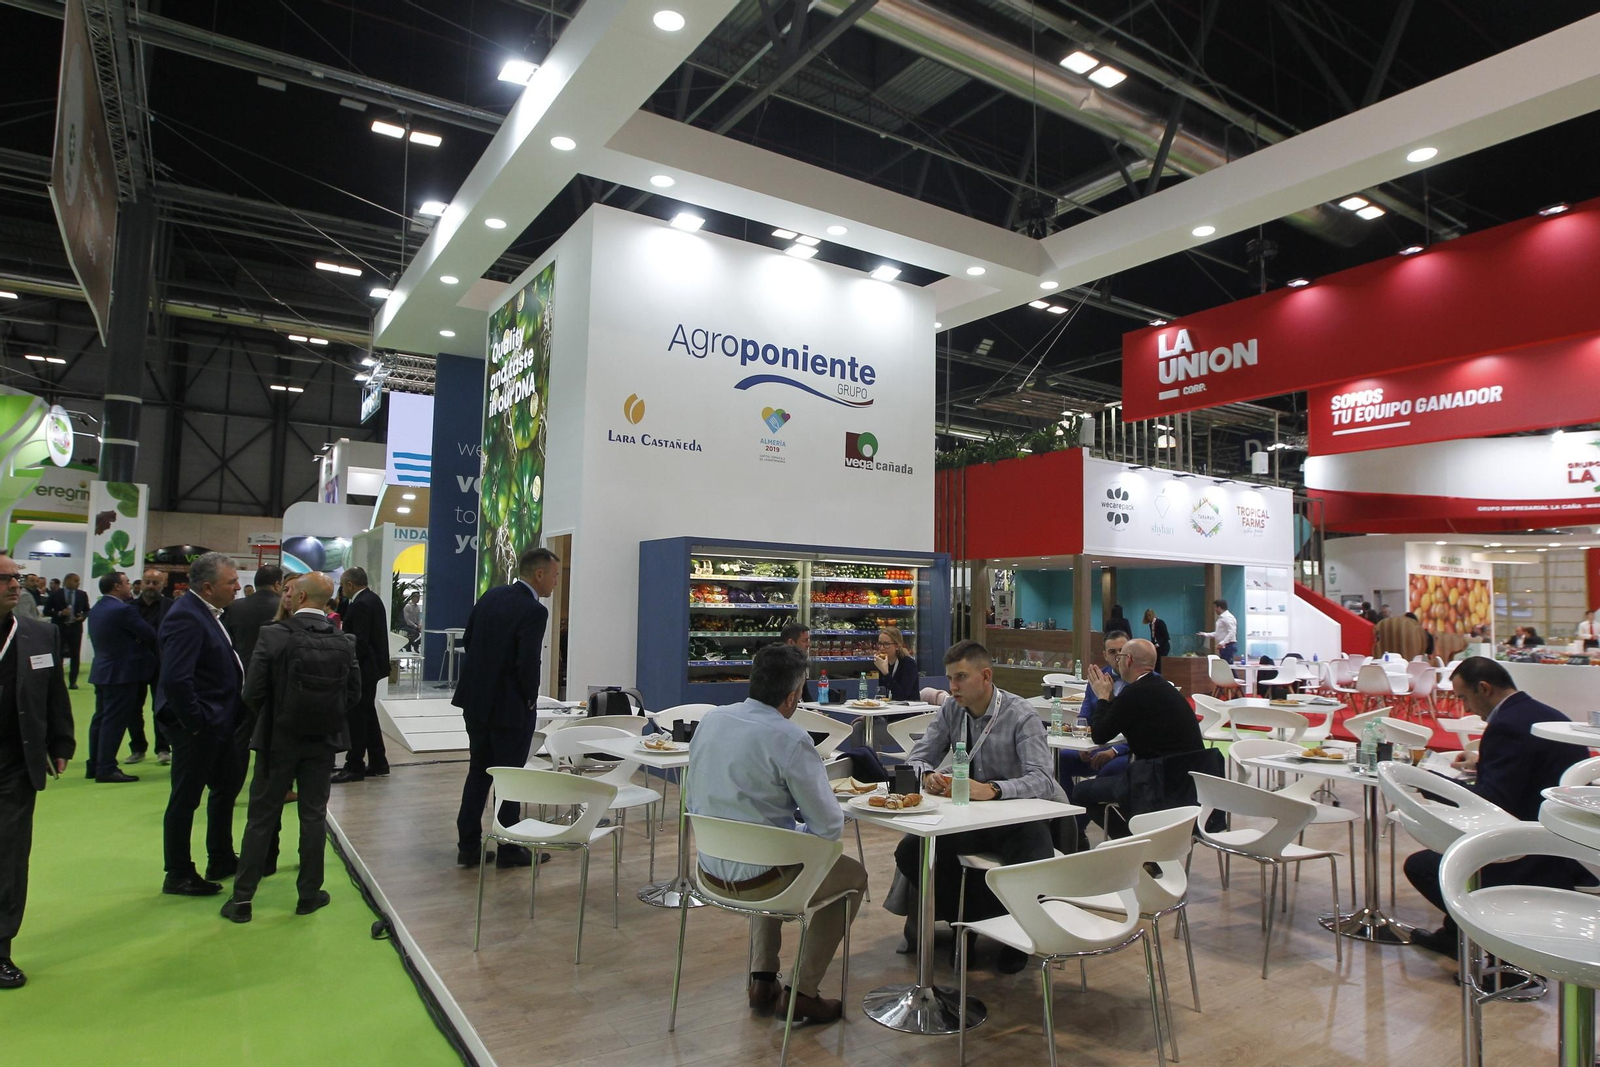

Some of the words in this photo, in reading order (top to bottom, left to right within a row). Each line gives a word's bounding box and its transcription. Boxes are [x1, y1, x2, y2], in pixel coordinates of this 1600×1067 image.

[492, 327, 525, 363] Quality
[1158, 329, 1194, 359] LA
[667, 323, 876, 385] Agroponiente
[1158, 338, 1258, 384] UNION
[490, 362, 508, 390] and
[508, 348, 534, 380] taste
[489, 390, 499, 418] in
[498, 389, 514, 413] our
[514, 372, 535, 404] DNA
[837, 383, 868, 399] GRUPO
[1183, 383, 1207, 395] CORP.
[1331, 388, 1383, 410] SOMOS
[1332, 408, 1352, 425] TU
[1354, 399, 1412, 422] EQUIPO
[1415, 385, 1503, 413] GANADOR
[765, 445, 780, 453] 2019
[1244, 439, 1262, 461] D
[845, 457, 873, 470] vega
[876, 462, 913, 475] cañada
[1567, 469, 1596, 483] LA
[33, 482, 90, 501] eregrin
[455, 506, 476, 524] to
[1101, 501, 1134, 511] wecarepack
[1237, 506, 1270, 519] TROPICAL
[1242, 518, 1265, 529] FARMS
